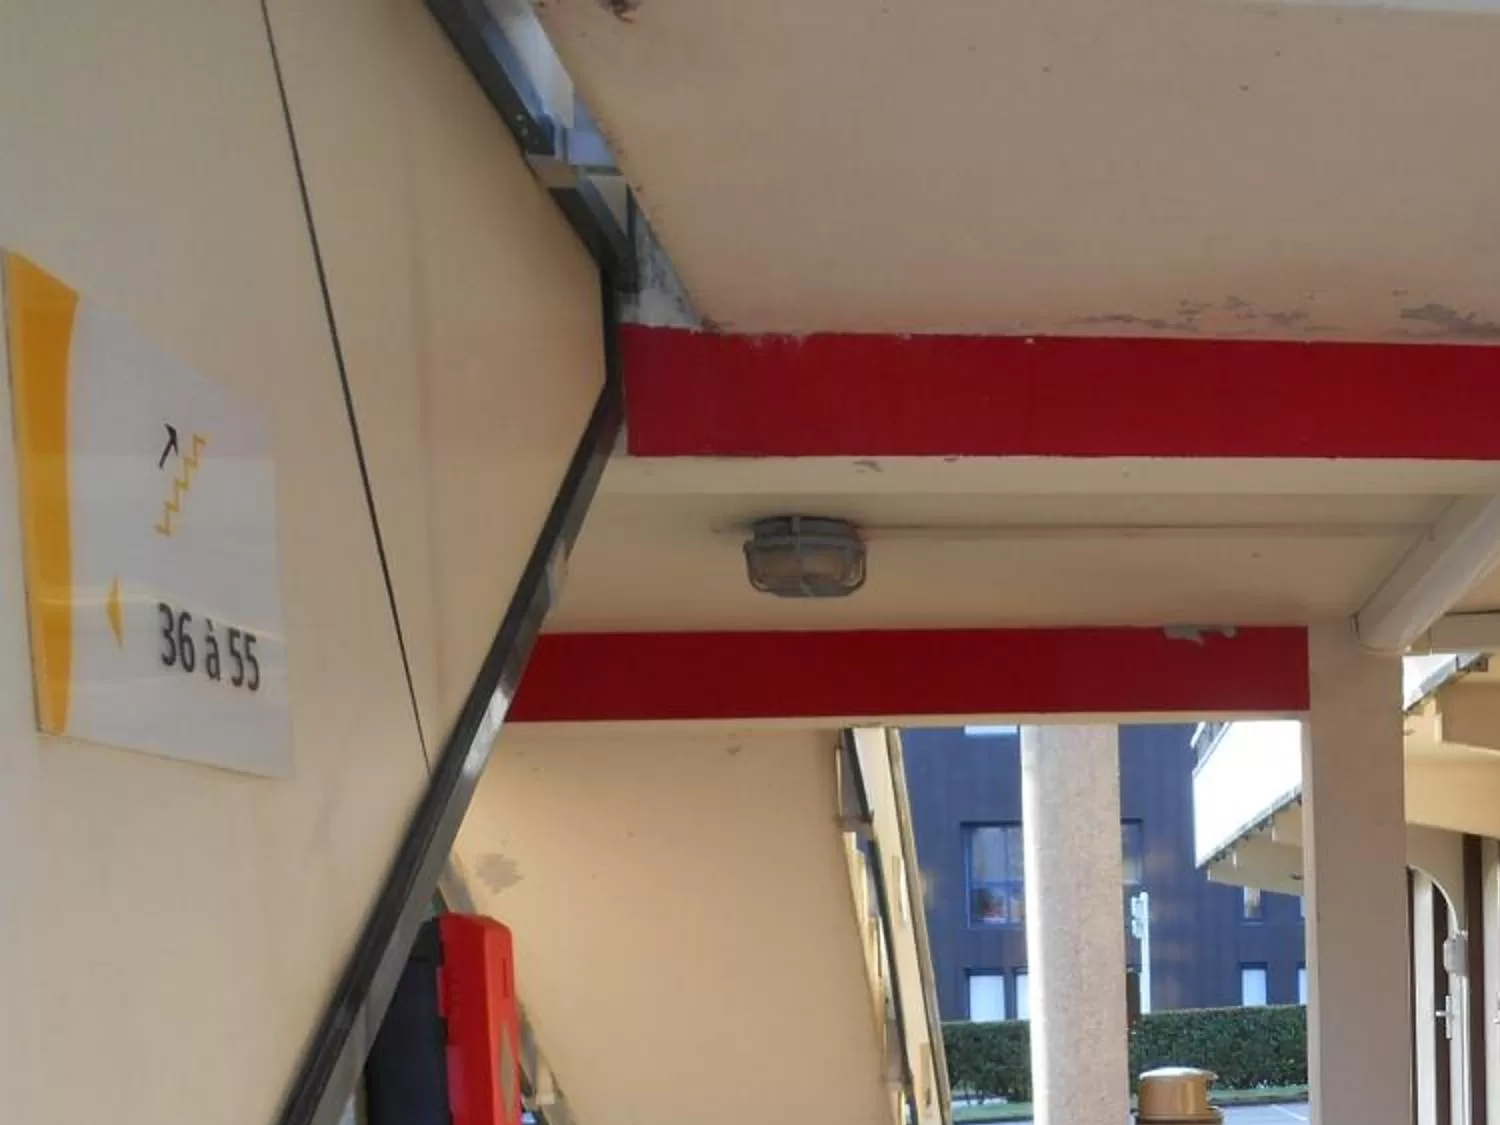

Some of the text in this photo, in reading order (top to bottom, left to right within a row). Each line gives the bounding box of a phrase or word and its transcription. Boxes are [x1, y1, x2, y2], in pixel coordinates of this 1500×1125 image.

[159, 602, 260, 692] 36 à 55
